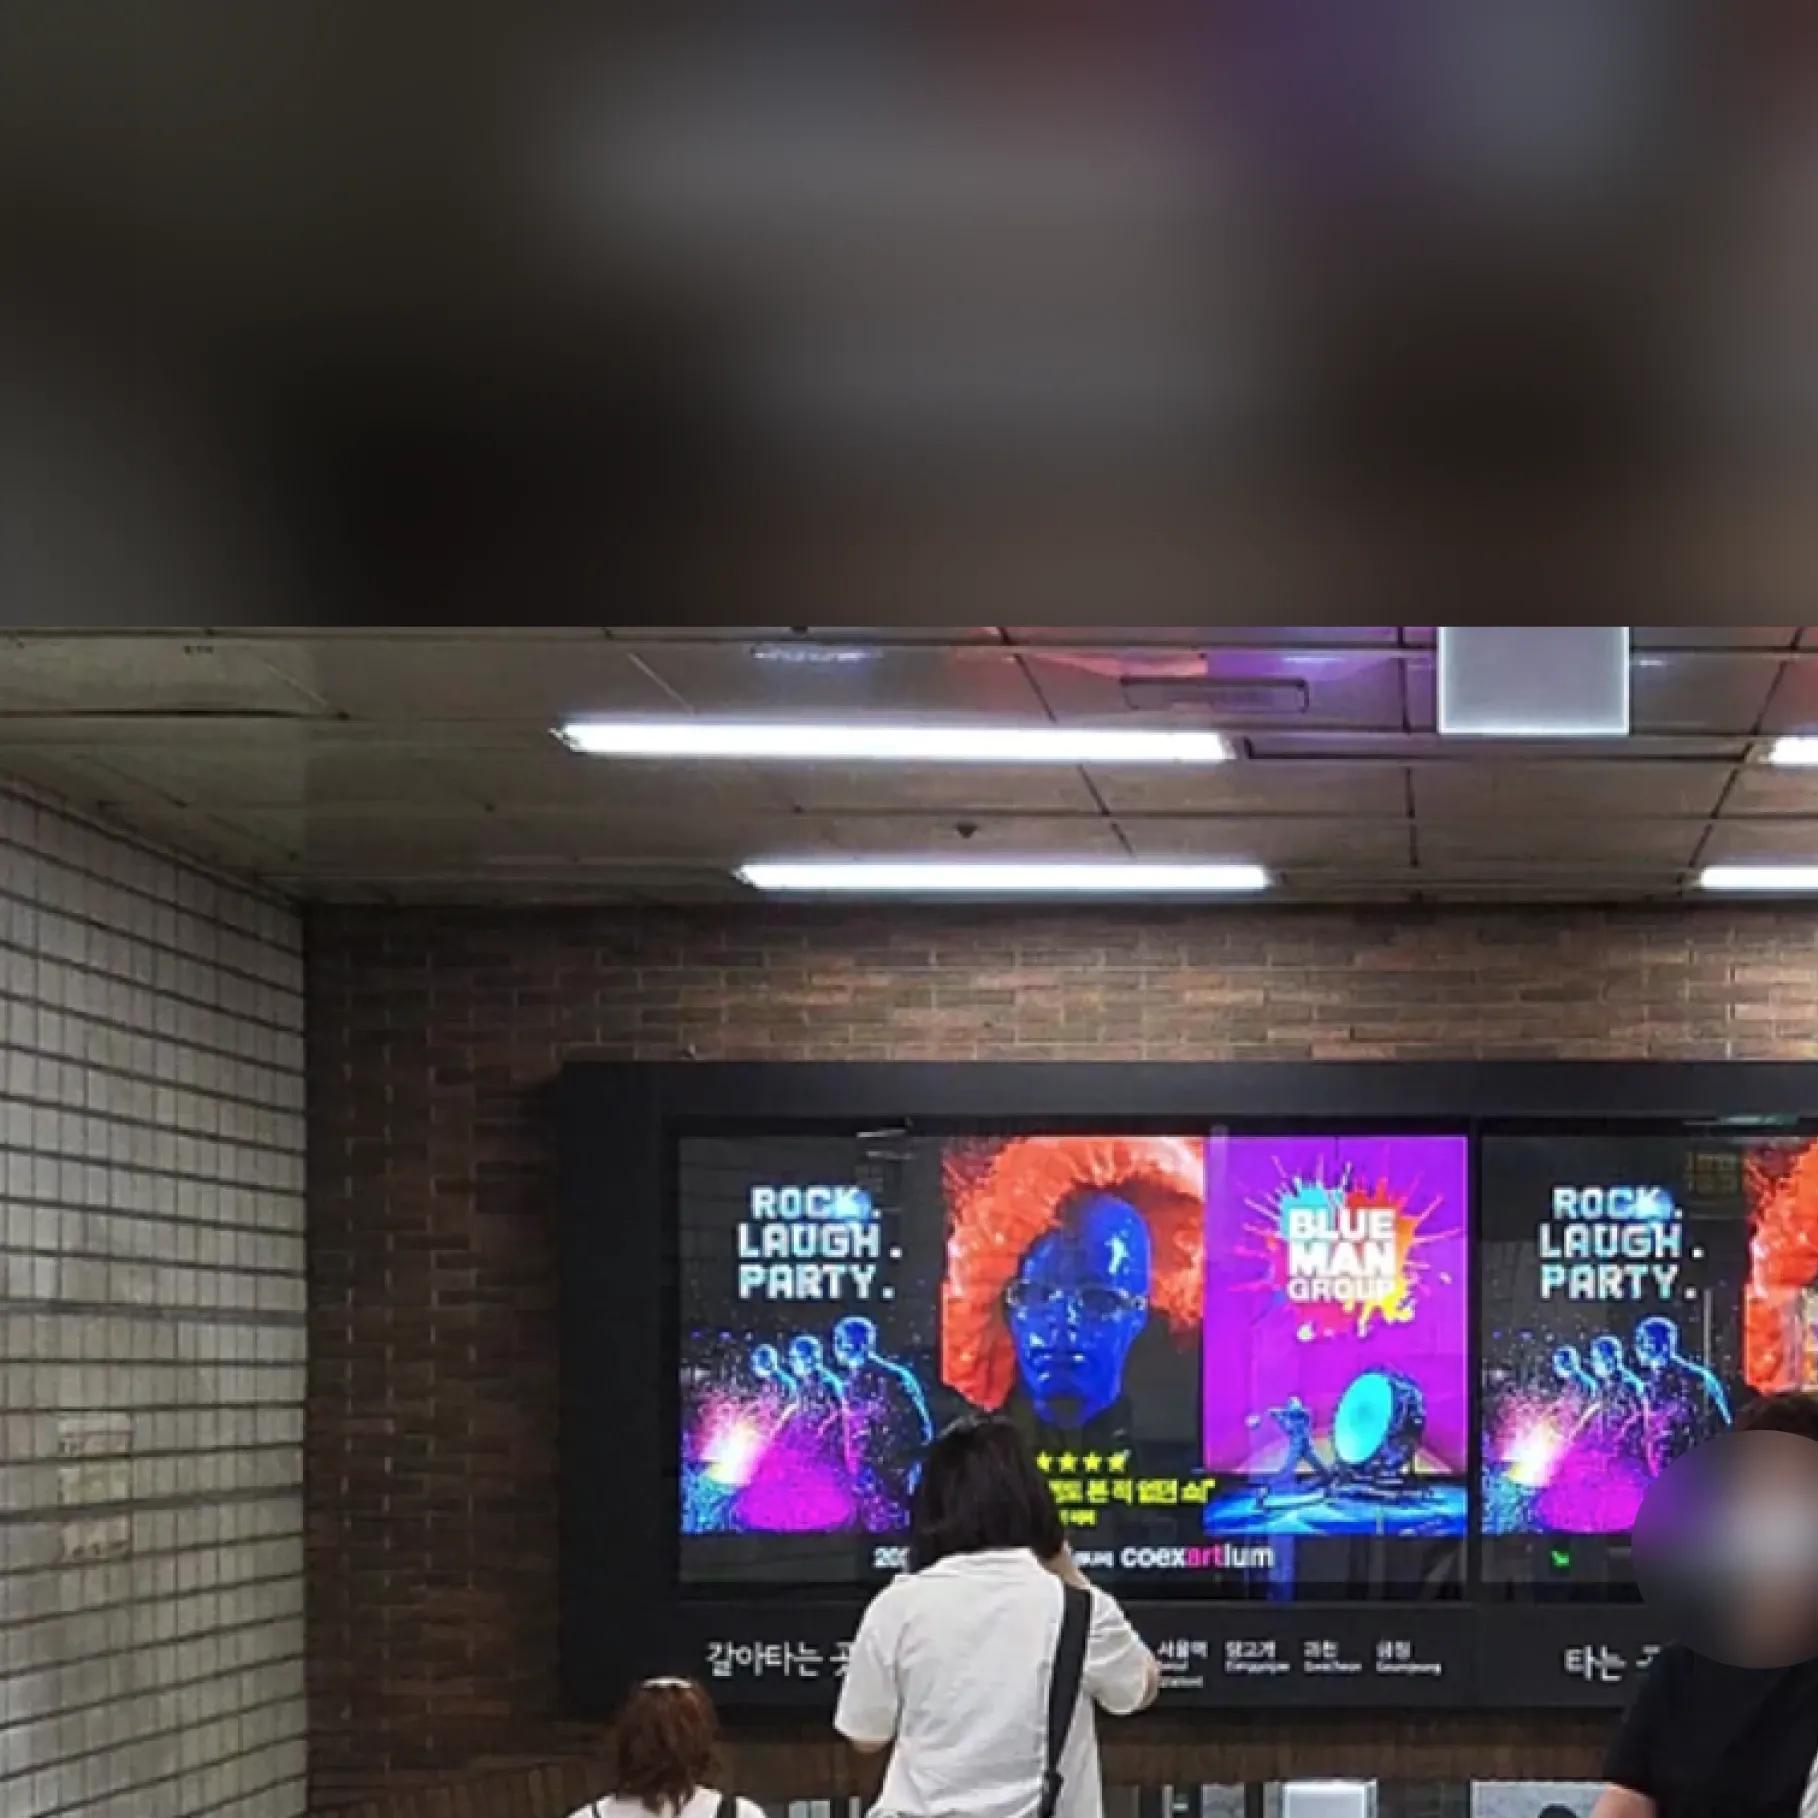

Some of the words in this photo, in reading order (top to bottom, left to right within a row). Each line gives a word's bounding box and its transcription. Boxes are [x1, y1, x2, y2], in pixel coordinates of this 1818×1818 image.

[1289, 1207, 1396, 1239] BLUE
[1289, 1241, 1396, 1275] MAN
[1288, 1277, 1396, 1303] GROUP
[1120, 1544, 1275, 1568] coexartium
[705, 1641, 824, 1677] 갈아타는
[1564, 1644, 1628, 1681] 타는
